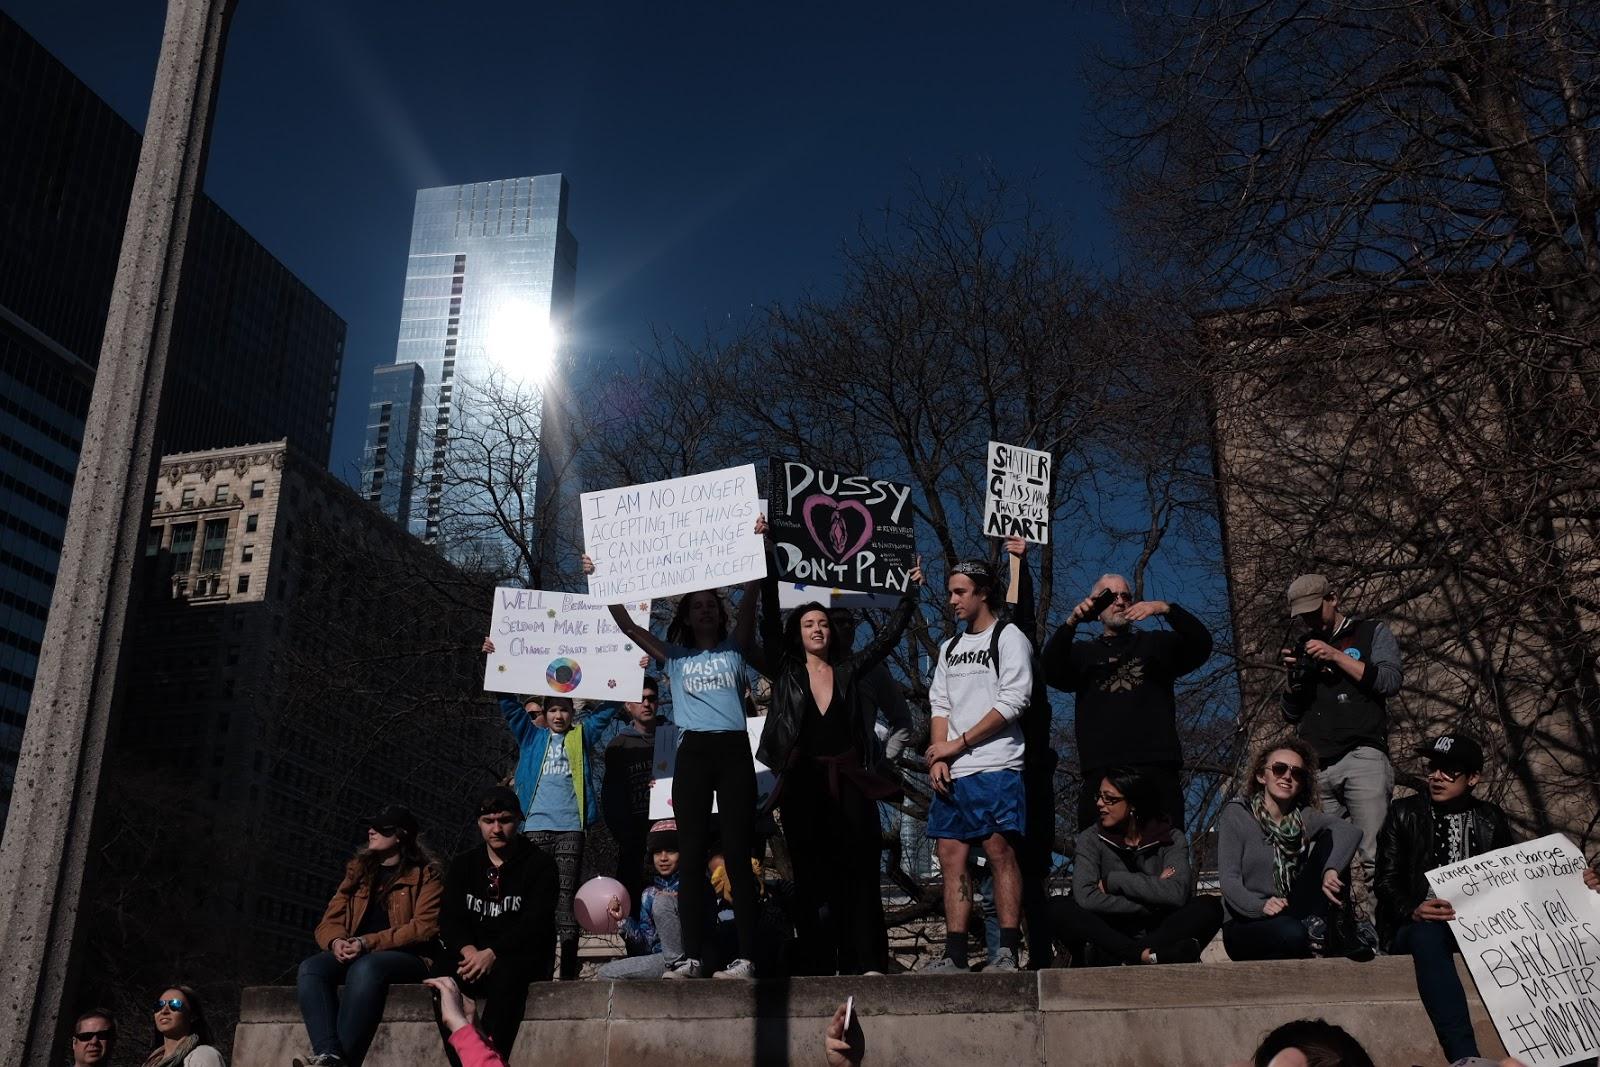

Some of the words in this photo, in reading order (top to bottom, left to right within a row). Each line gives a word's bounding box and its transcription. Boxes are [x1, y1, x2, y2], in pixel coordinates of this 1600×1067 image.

[994, 445, 1048, 480] SHATTER
[589, 496, 606, 520] I
[614, 491, 641, 517] AM
[649, 488, 675, 510] NO
[681, 476, 746, 505] LONGER
[784, 462, 911, 525] PUSSY
[990, 475, 1030, 502] GLASS
[591, 515, 666, 542] ACCEPTING
[669, 510, 691, 529] THE
[697, 501, 753, 525] THINGS
[988, 512, 1048, 541] APART
[993, 499, 1017, 514] THAT
[1032, 507, 1043, 520] US
[591, 543, 604, 561] I
[608, 535, 673, 558] CANNOT
[678, 521, 748, 548] CHANGE
[609, 559, 632, 576] AM
[636, 549, 703, 572] CHANGING
[706, 541, 738, 558] THE
[591, 578, 636, 599] THINGS
[637, 575, 648, 592] I
[651, 565, 698, 588] CANNOT
[704, 553, 761, 579] ACCEPT
[774, 542, 848, 583] DON'T
[856, 550, 911, 593] PLAY
[501, 590, 547, 610] WELL
[499, 616, 545, 634] SELDOM
[553, 619, 589, 636] MAKE
[682, 657, 728, 676] NASTY
[685, 671, 736, 693] WOMAN
[542, 759, 572, 775] OMA
[1431, 864, 1473, 885] women
[1474, 860, 1499, 870] are
[1496, 854, 1515, 866] in
[1515, 847, 1565, 866] charge
[1462, 874, 1479, 896] of
[1483, 868, 1517, 888] their
[1524, 864, 1550, 880] own
[1549, 856, 1587, 876] bodies
[1457, 907, 1525, 942] Science
[1517, 901, 1544, 930] is
[1542, 889, 1578, 928] real
[1480, 933, 1556, 988] BLACK
[1546, 923, 1600, 969] LIVES
[1521, 967, 1600, 1008] MATTER
